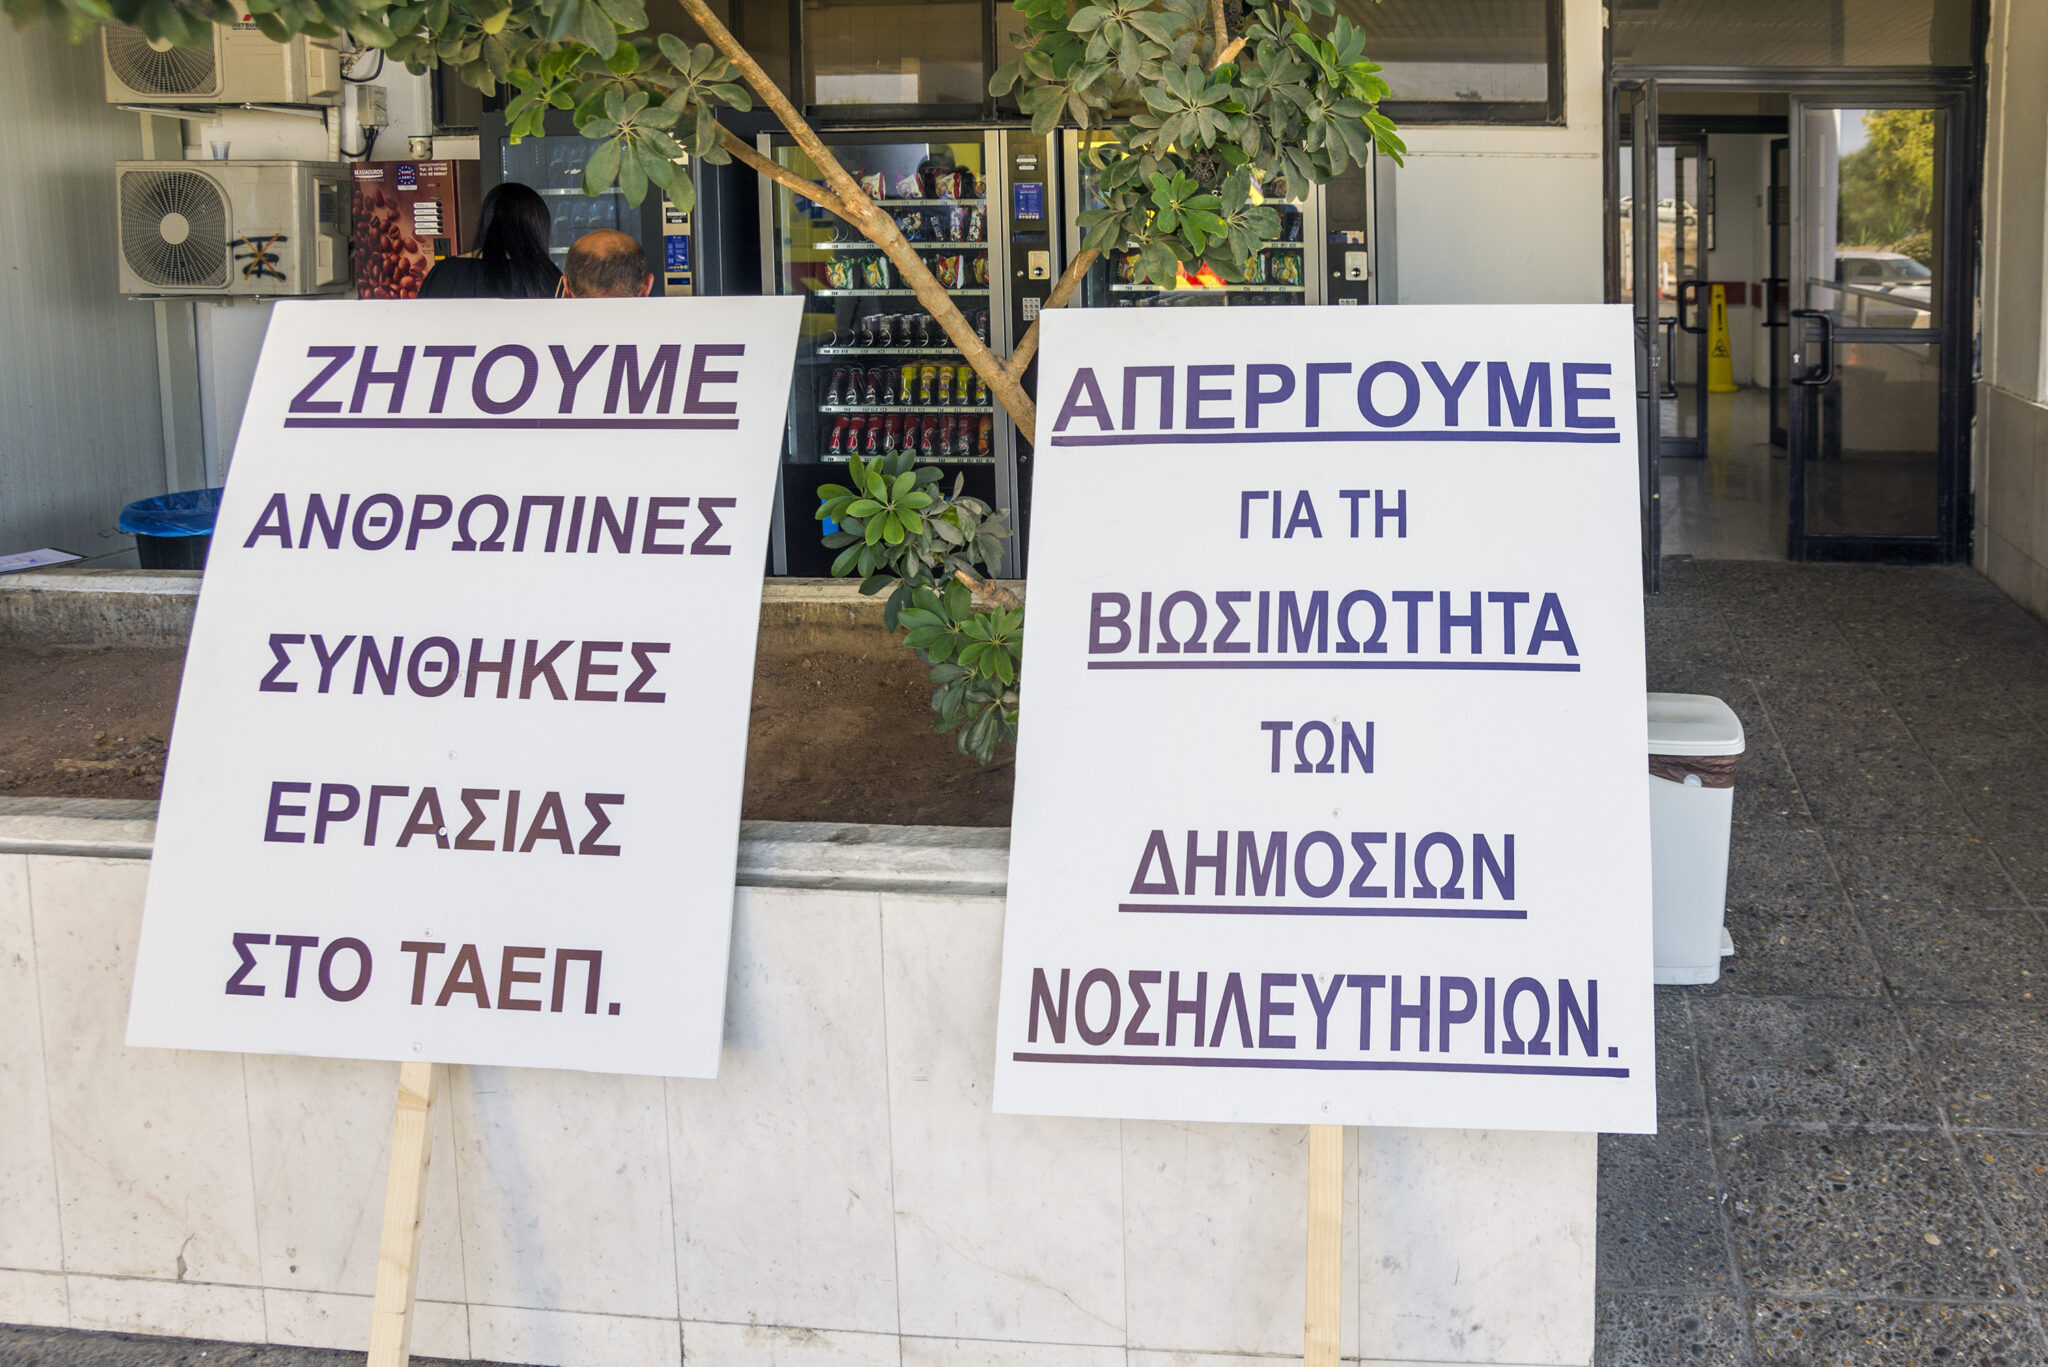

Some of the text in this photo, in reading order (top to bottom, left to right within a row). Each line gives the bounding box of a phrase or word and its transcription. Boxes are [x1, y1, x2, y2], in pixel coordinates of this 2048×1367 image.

[289, 344, 745, 415] ΖΗΤΟΥΜΕ
[1053, 361, 1615, 431] ΑΠΕΡΓΟΥΜΕ
[243, 493, 736, 555] ΑΝΘΡΩΠΙΝΕΣ
[1240, 490, 1407, 539] ΓΙΑ ΤΗ
[1088, 590, 1580, 656] ΒΙΩΣΙΜΩΤΗΤΑ
[259, 634, 671, 703] ΣΥΝΘΗΚΕΣ
[1261, 721, 1375, 773] ΤΩΝ
[264, 782, 625, 857] ΕΡΓΑΣΙΑΣ
[1129, 830, 1515, 900] ΔΗΜΟΣΙΩΝ
[225, 933, 621, 1016] ΣΤΟ ΤΑΕΠ.
[1028, 968, 1619, 1058] ΝΟΣΗΛΕΥΤΗΡΙΩΝ.
